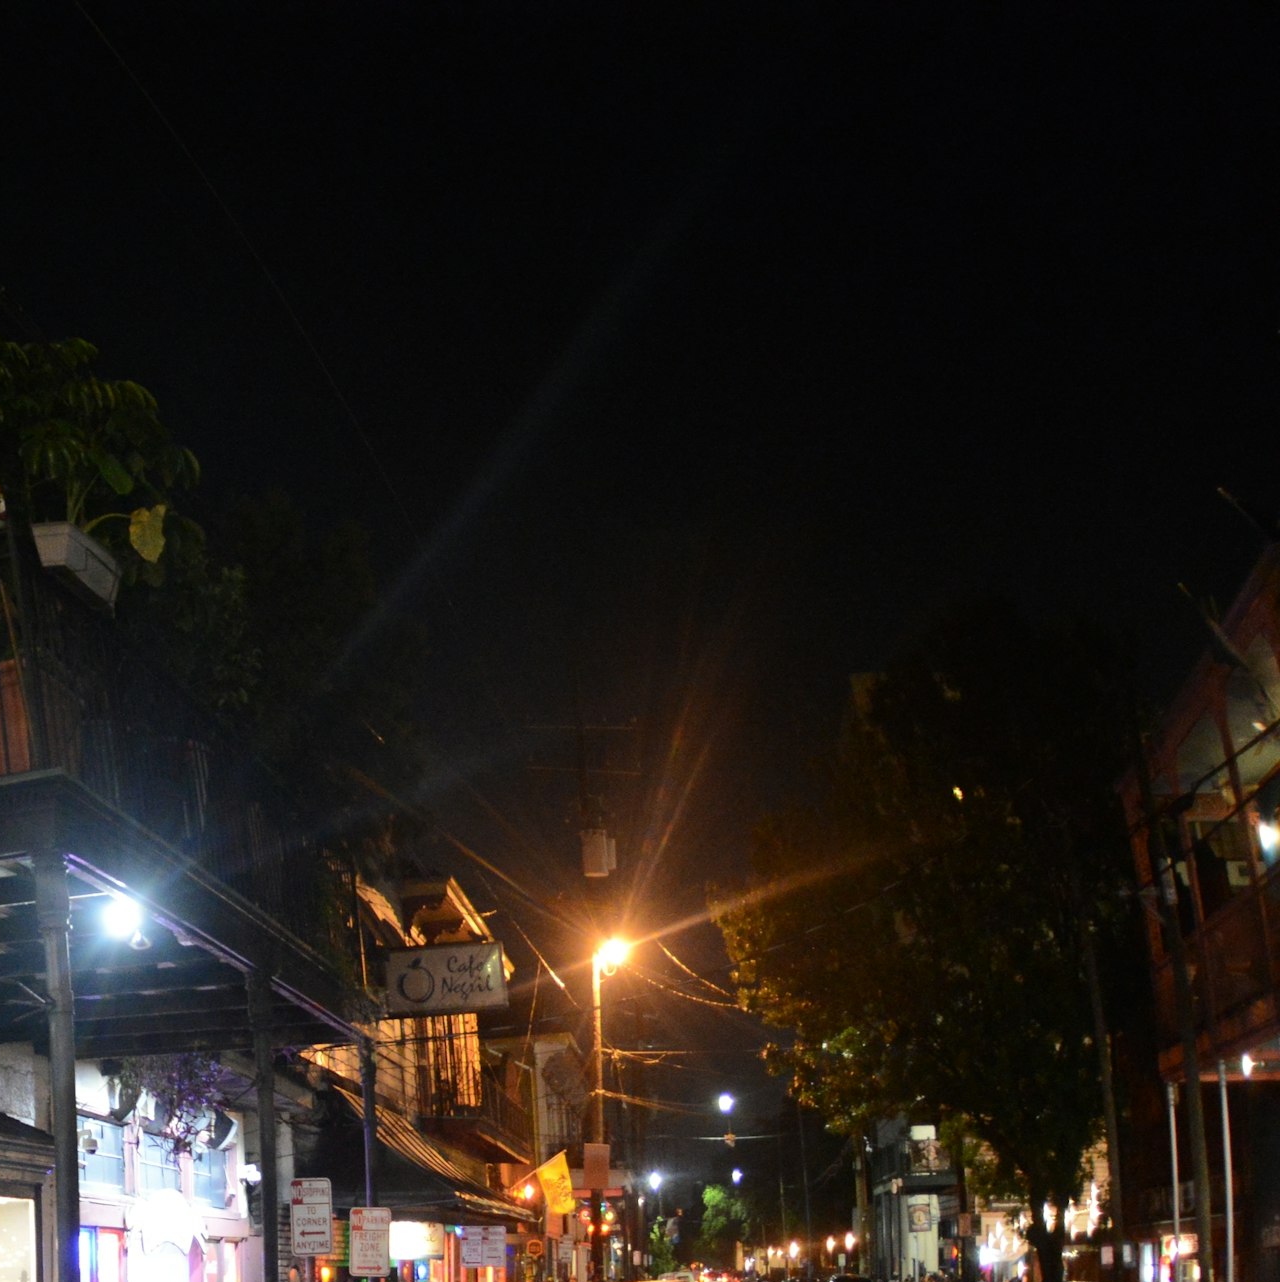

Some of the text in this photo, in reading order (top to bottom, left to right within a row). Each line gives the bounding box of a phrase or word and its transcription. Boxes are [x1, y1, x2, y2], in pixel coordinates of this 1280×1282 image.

[441, 974, 493, 1000] Negril
[292, 1186, 329, 1199] NO STOPPING
[306, 1206, 317, 1215] TO
[296, 1217, 327, 1226] CORNER
[363, 1215, 391, 1225] PARKING
[354, 1231, 386, 1240] FREIGHT
[296, 1240, 329, 1249] ANYTIME
[360, 1243, 380, 1252] ZONE
